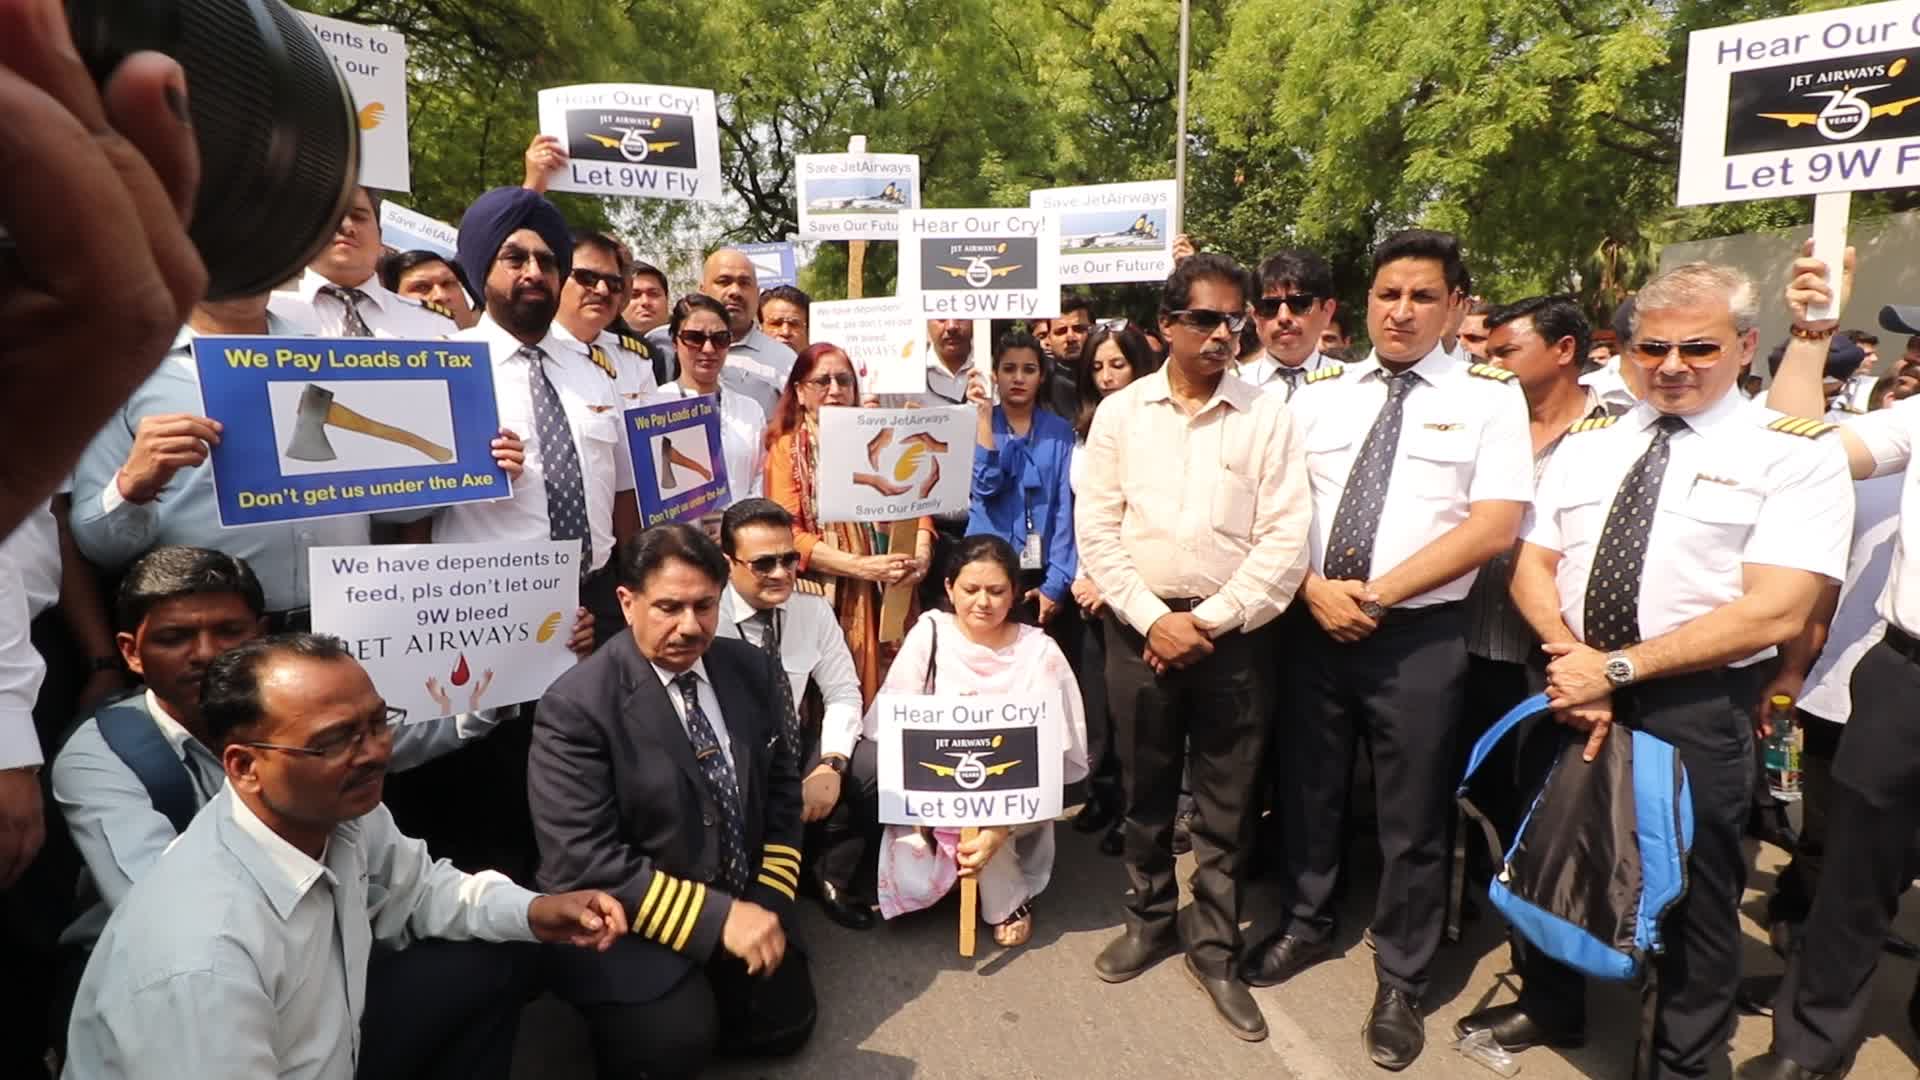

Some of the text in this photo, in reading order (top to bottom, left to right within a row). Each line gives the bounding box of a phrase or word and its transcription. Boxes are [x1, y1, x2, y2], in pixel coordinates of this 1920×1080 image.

[314, 24, 389, 55] ents to
[1717, 33, 1811, 65] Hear
[1821, 22, 1899, 49] Our
[345, 60, 380, 77] our
[1788, 64, 1886, 92] JET AIRWAYS
[556, 90, 700, 114] Hear Our Cry!
[600, 115, 653, 127] JET AIRWAYS
[1828, 114, 1860, 126] YEARS
[806, 161, 912, 175] Save JetAirways
[1725, 156, 1795, 191] Let
[1808, 147, 1882, 183] 9W
[572, 163, 699, 197] Let 9W Fly
[1043, 191, 1168, 209] Save JetAirways
[418, 223, 455, 243] JetAir
[808, 220, 898, 232] Save Our Futu
[912, 215, 1047, 236] Hear Our Cry!
[950, 244, 997, 254] JET AIRWAYS
[1059, 259, 1166, 275] ve Our Future
[922, 293, 1039, 316] Let 9W Fly
[224, 348, 474, 372] We Pay Loads of Tax
[635, 416, 650, 431] We
[857, 414, 950, 427] Save JetAirways
[238, 472, 494, 509] Don't get us under the Axe
[855, 498, 942, 516] Save Our Family
[331, 551, 570, 575] We have dependents to
[345, 577, 561, 603] feed, pls don't let our
[416, 604, 509, 626] 9W bleed
[404, 621, 529, 655] AIRWAYS
[892, 700, 1048, 725] Hear Our Cry!
[935, 737, 991, 750] JET AIRWAYS
[904, 793, 1041, 820] Let 9W Fly
